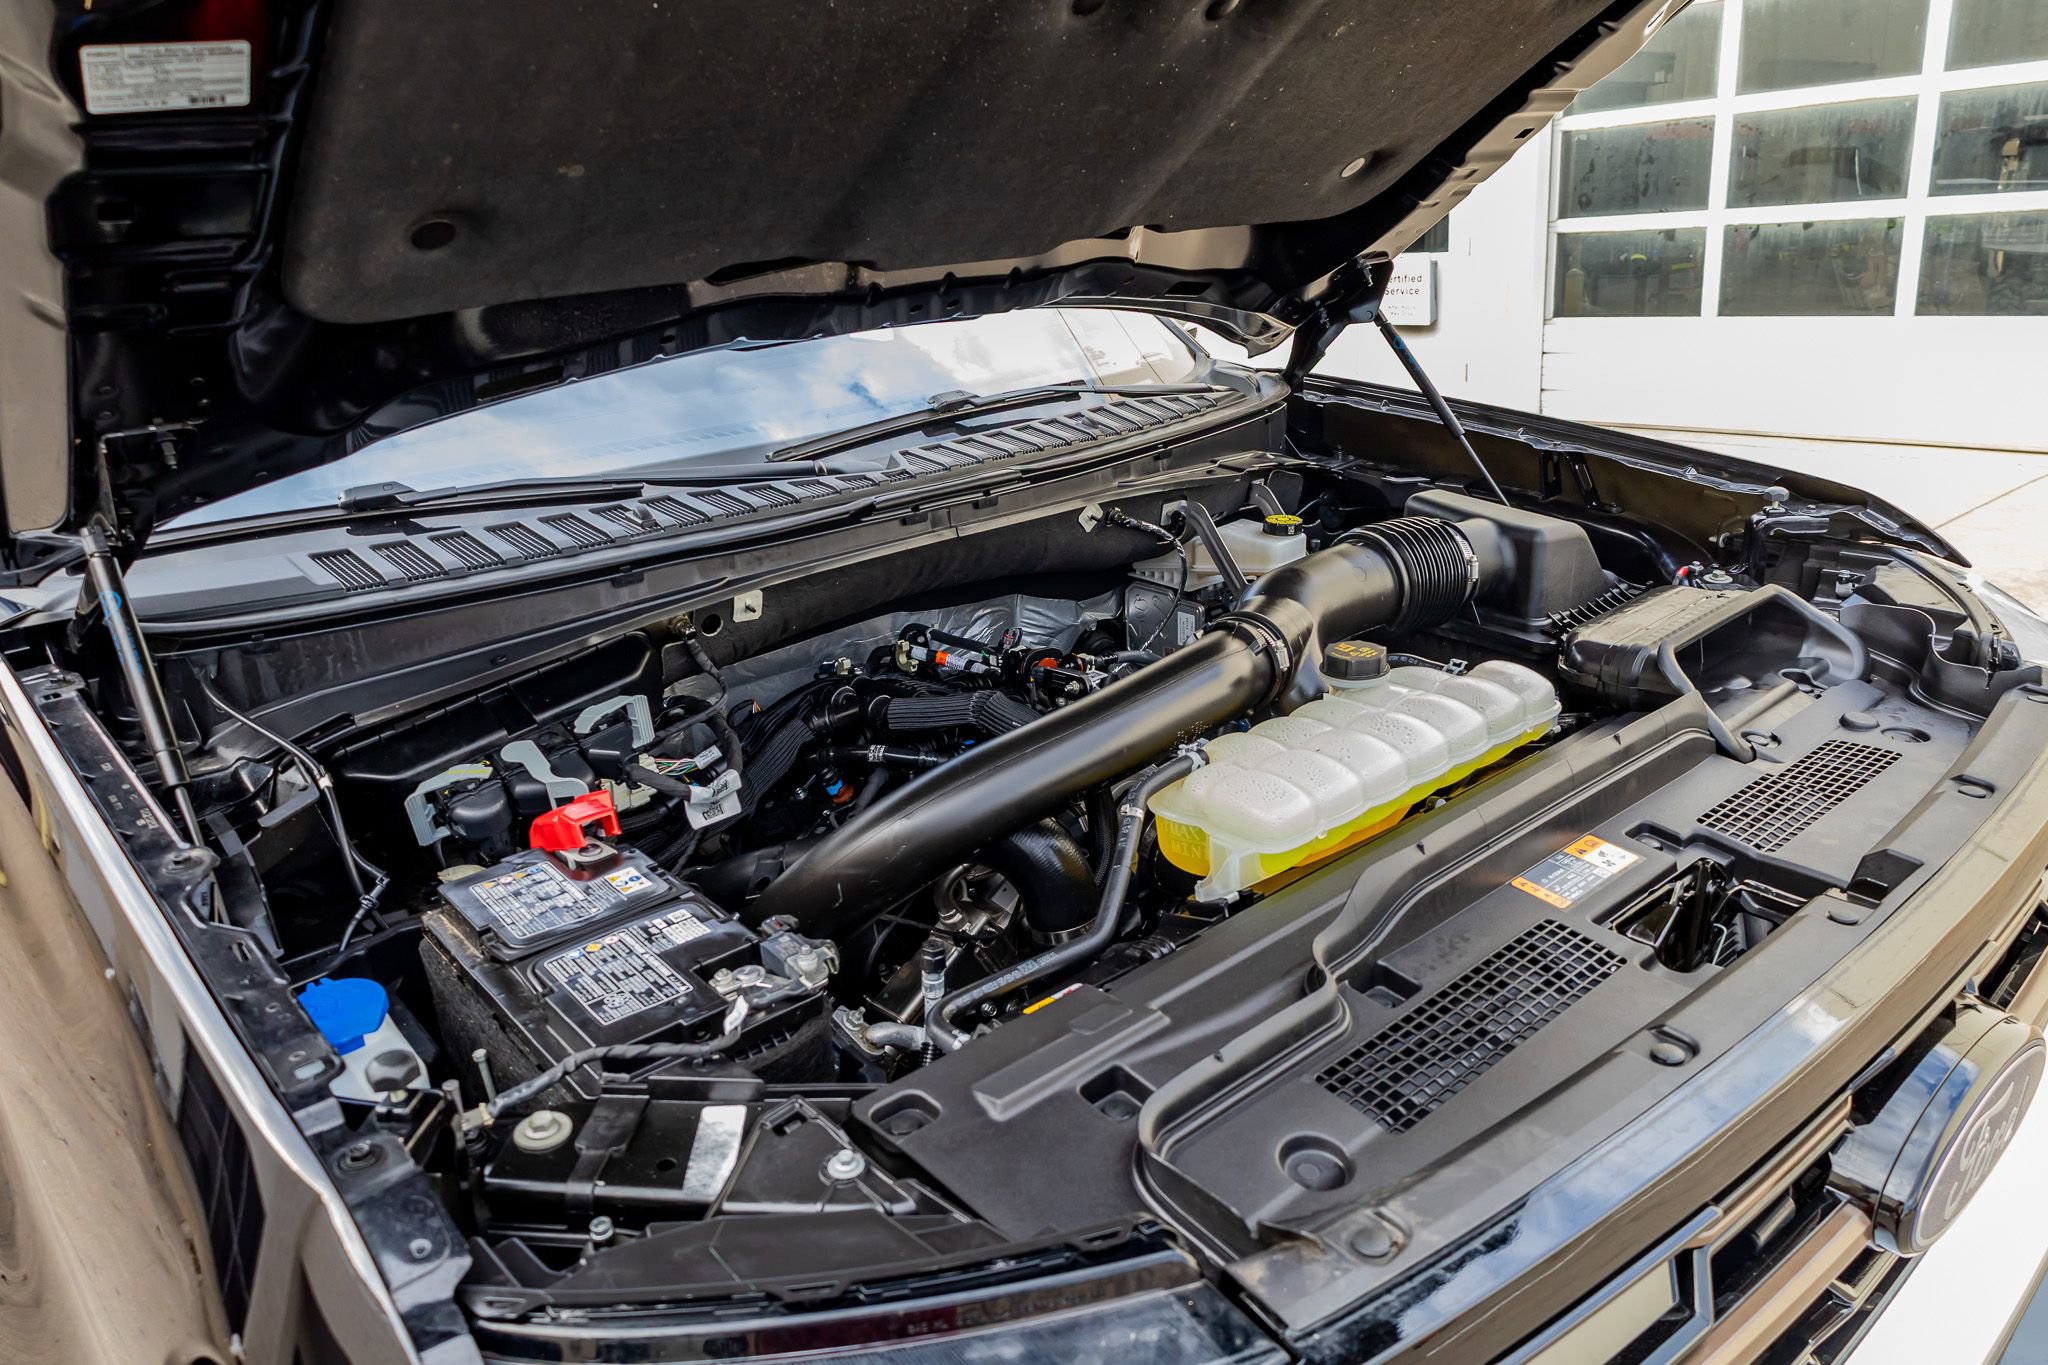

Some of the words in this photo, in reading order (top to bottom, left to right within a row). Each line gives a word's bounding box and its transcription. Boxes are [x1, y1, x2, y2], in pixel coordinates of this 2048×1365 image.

[1389, 274, 1423, 283] ertified
[1384, 286, 1420, 296] Service
[1169, 822, 1200, 841] MAX
[1171, 839, 1201, 858] MIN
[1945, 1074, 2030, 1221] Ford
